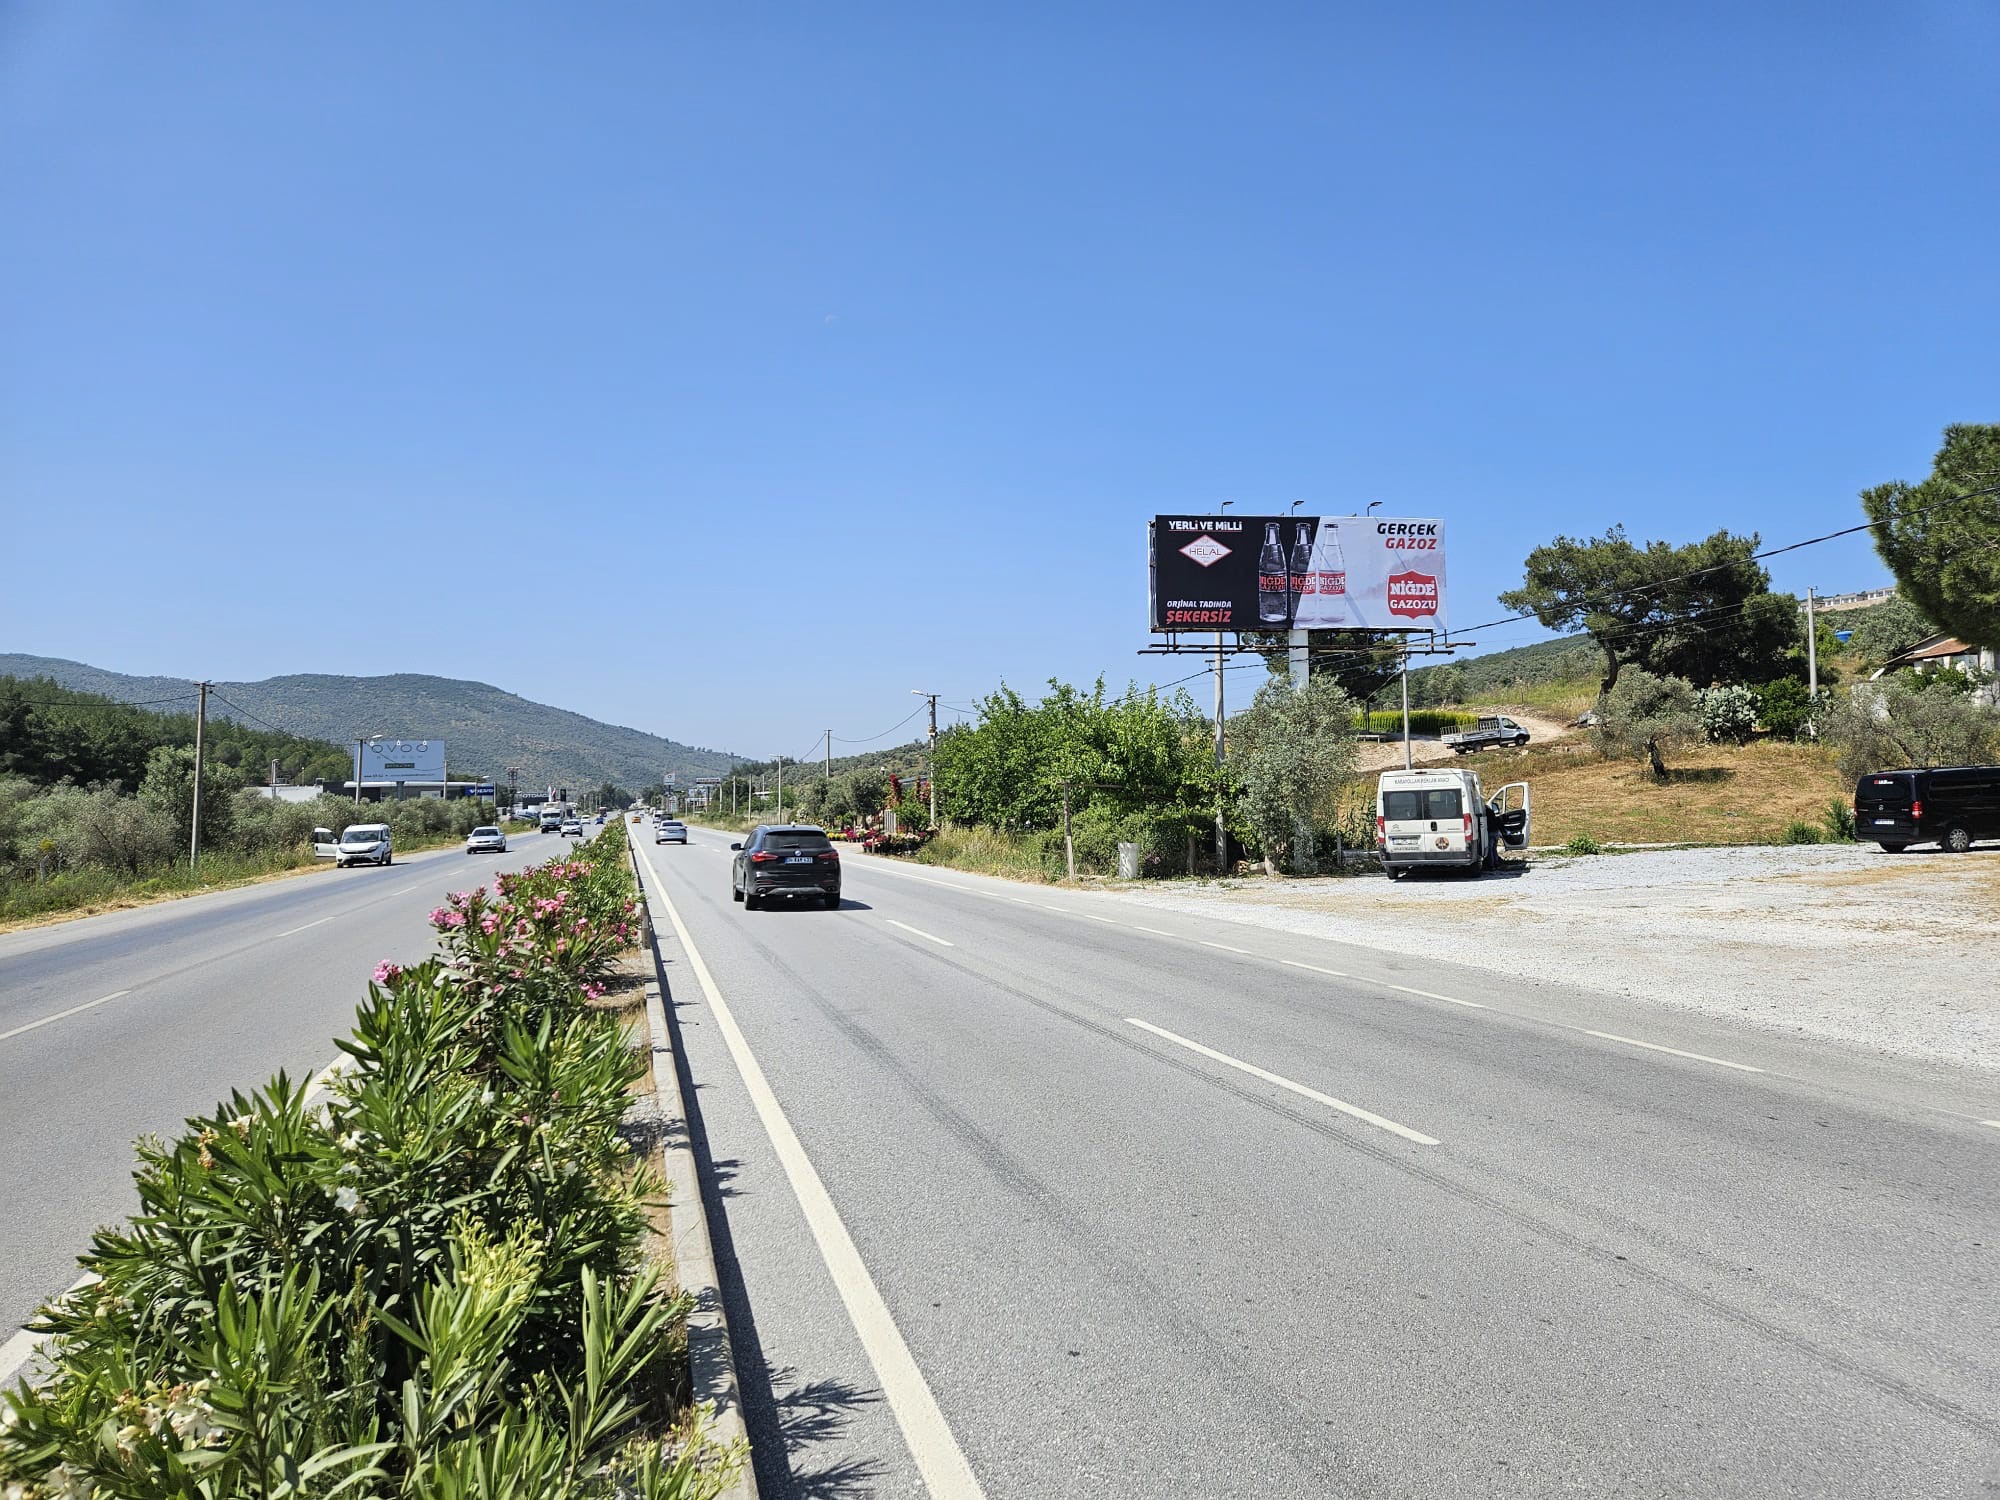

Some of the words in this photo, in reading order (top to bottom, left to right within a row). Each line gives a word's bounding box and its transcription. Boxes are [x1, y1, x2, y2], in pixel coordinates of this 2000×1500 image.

[1199, 521, 1214, 530] VE
[1377, 523, 1437, 537] GERÇEK
[1385, 537, 1437, 550] GAZOZ
[1190, 548, 1223, 556] HELAL
[1390, 580, 1435, 595] NİĞDE
[1199, 600, 1232, 608] TADINDA
[1390, 599, 1437, 609] GAZOZU
[1166, 608, 1232, 624] ŞEKERSİZ
